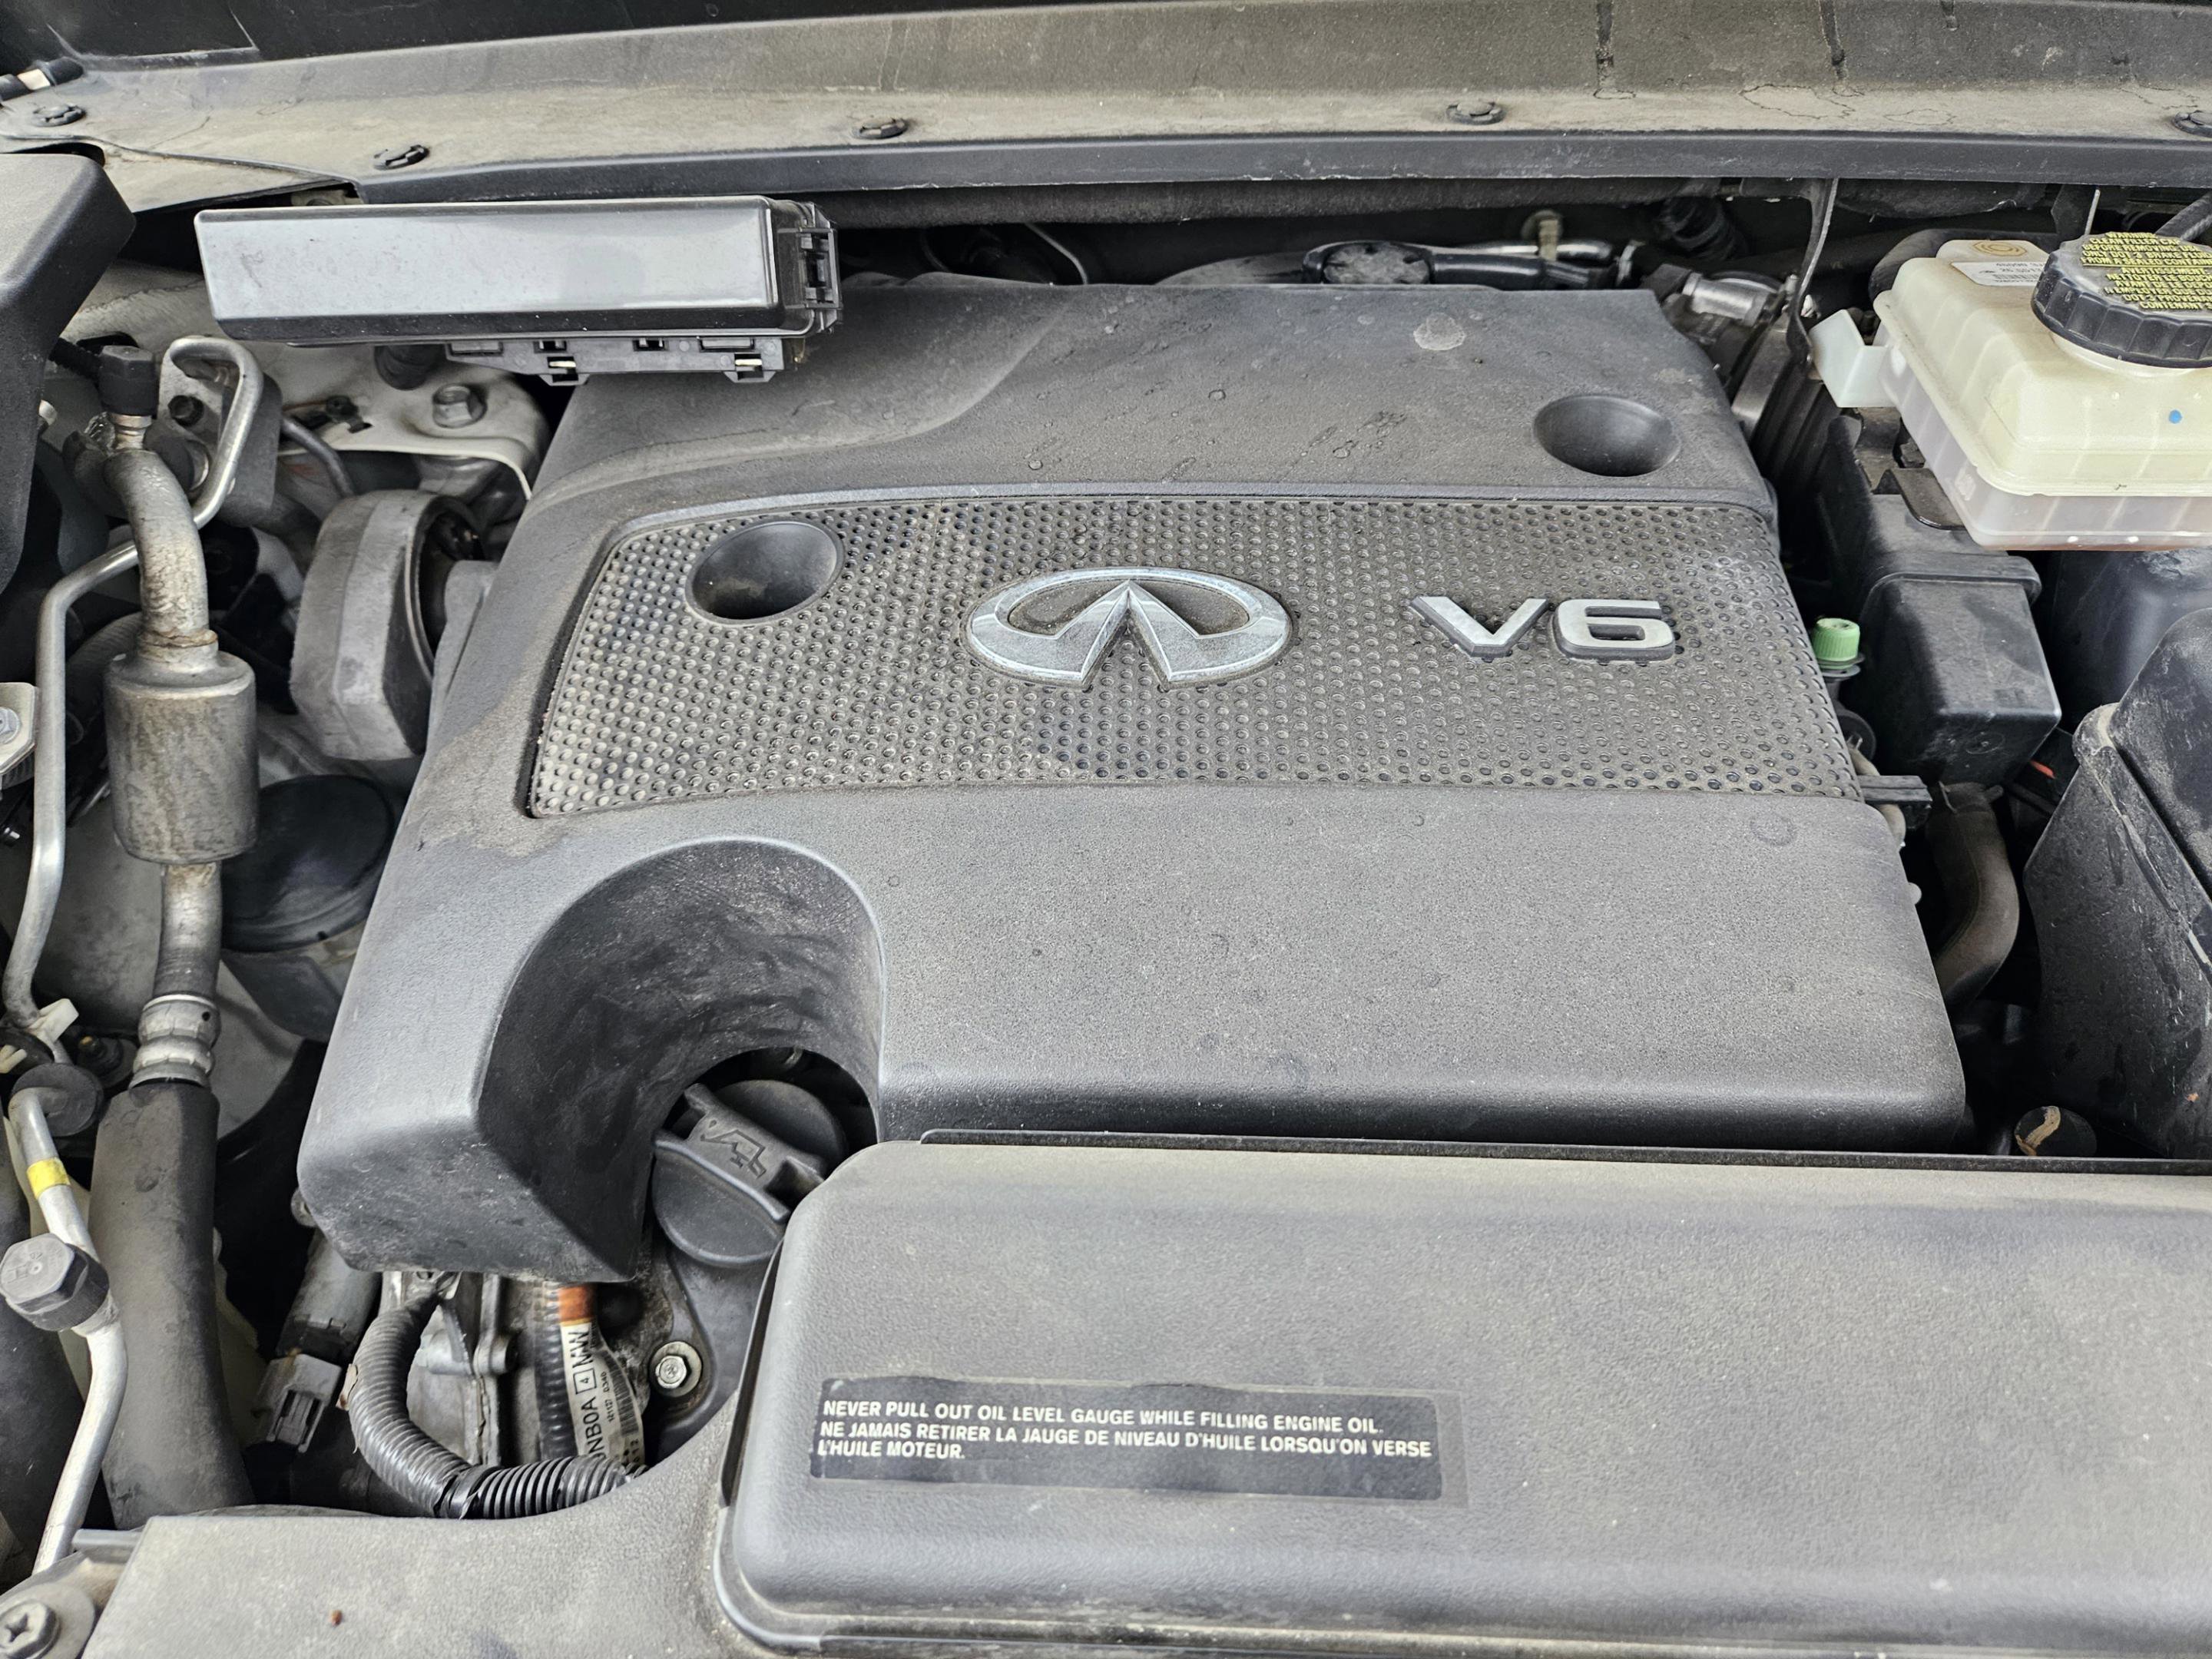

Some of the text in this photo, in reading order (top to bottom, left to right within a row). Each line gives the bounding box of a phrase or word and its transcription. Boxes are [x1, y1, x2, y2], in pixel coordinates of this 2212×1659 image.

[2139, 301, 2204, 310] CONTENANT
[1412, 596, 1675, 660] V6
[823, 1400, 1384, 1434] NEVER PULL OUT OIL LEVEL GAUGE WHILE FILLING ENGINE OIL.
[817, 1439, 965, 1459] L'HUILE MOTEUR.
[820, 1421, 1432, 1458] NE JAMAIS RETIRER LA JAUGE DE NIVEAU D'HUILE LORSQU'ON VERSE
